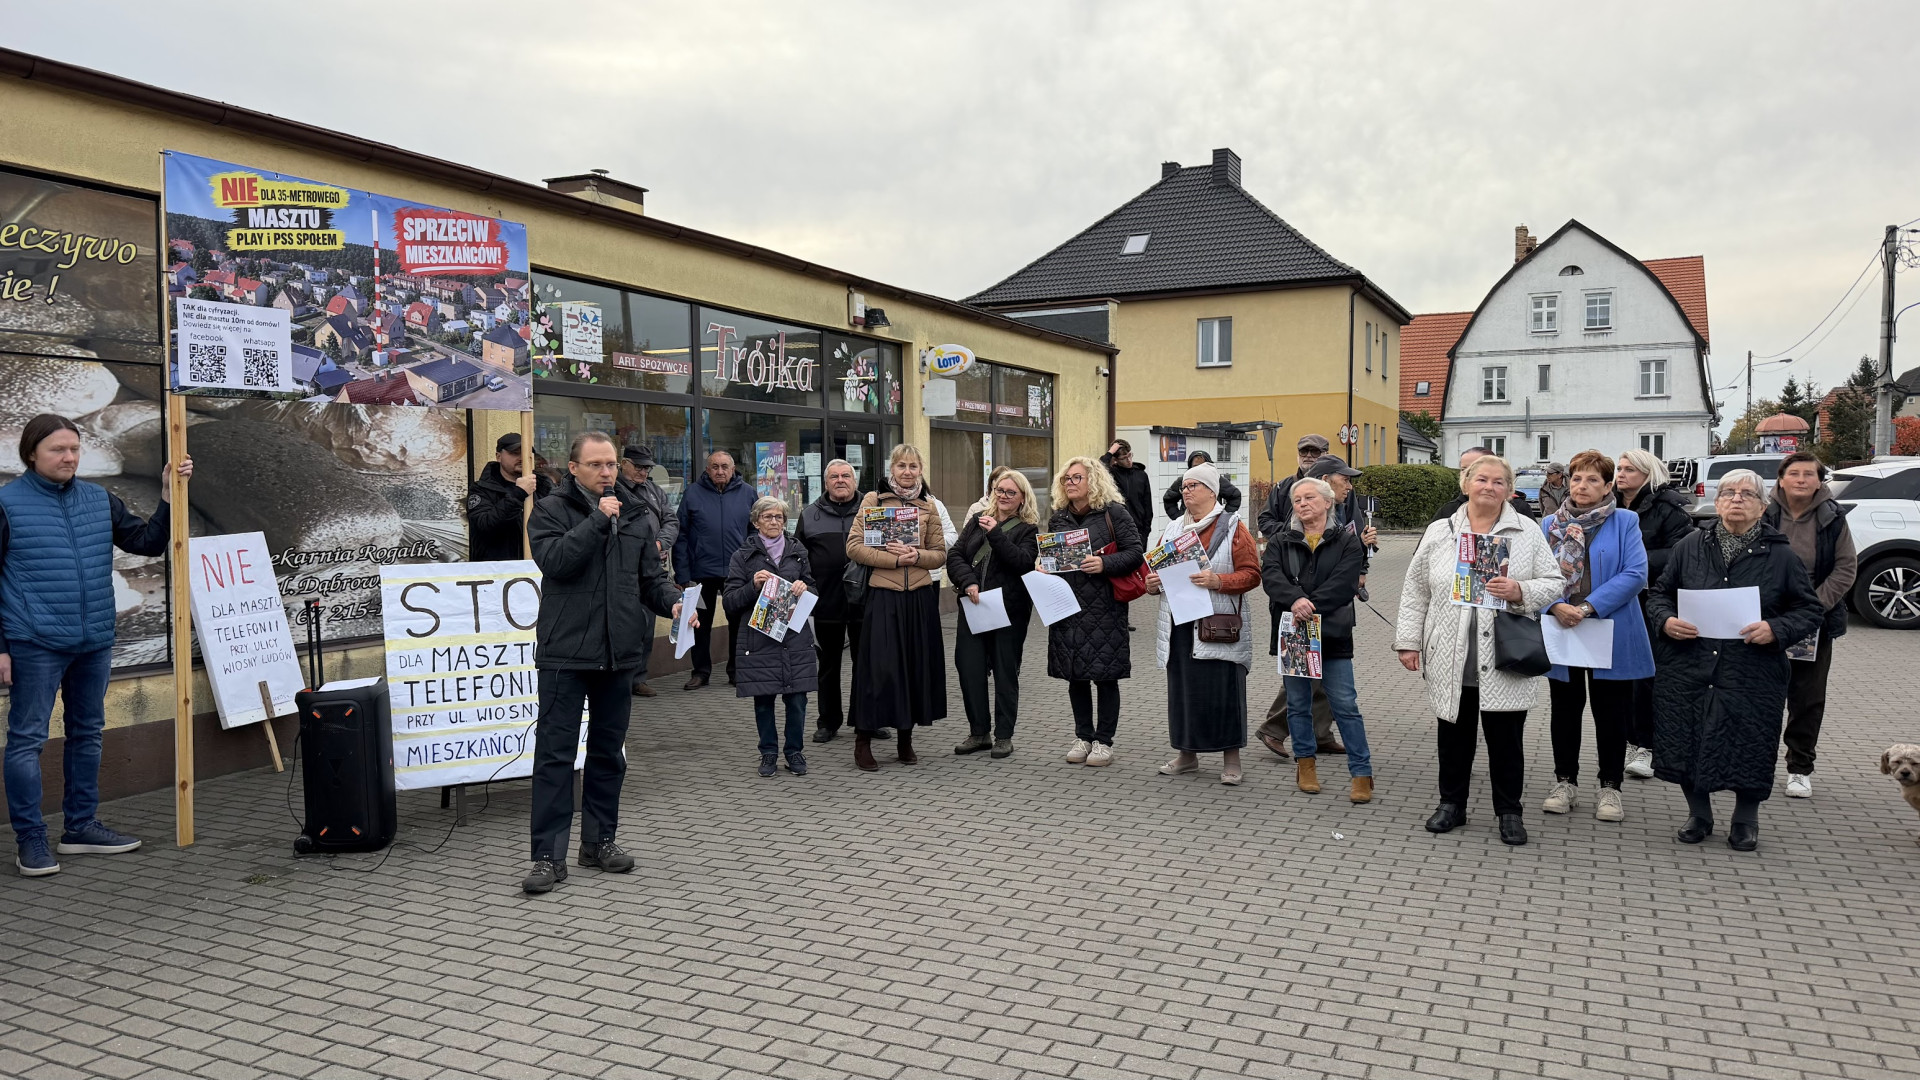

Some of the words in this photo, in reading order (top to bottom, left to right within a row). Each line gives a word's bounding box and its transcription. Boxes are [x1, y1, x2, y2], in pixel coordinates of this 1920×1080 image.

[221, 177, 259, 202] NIE
[261, 188, 277, 201] DLA
[278, 189, 340, 204] 35-METROWEGO
[248, 208, 320, 229] MASZTU
[236, 232, 264, 246] PLAY
[267, 232, 271, 245] i
[274, 233, 294, 246] PSS
[296, 233, 337, 246] SPOŁEM
[403, 217, 489, 243] SPRZECIW
[0, 223, 138, 269] eczywo
[405, 243, 502, 265] MIESZKAŃCÓW!
[0, 270, 34, 302] ie
[182, 303, 196, 312] TAK
[197, 305, 207, 313] dla
[208, 307, 240, 316] cyfryzacji.
[182, 312, 194, 320] NIE
[196, 313, 206, 321] dla
[208, 315, 230, 323] masztu
[231, 316, 246, 325] 10m
[183, 320, 212, 329] Dowiedz
[190, 332, 224, 342] facebook
[243, 338, 276, 347] whatsapp
[618, 355, 637, 368] ART.
[706, 322, 815, 394] Trójka
[937, 354, 961, 369] LOTTO
[270, 546, 353, 569] ekarnia
[358, 540, 438, 565] Rogalik
[201, 550, 255, 592] NIE
[297, 572, 381, 598] Dąbrow
[211, 605, 236, 619] DLA
[240, 596, 282, 614] MASZTU
[400, 577, 542, 638] STO
[214, 620, 279, 643] TELEFONII
[230, 642, 249, 657] PRZY
[254, 638, 278, 651] ULICY
[222, 655, 258, 675] WIOSNY
[399, 655, 424, 670] DLA
[403, 670, 538, 707] TELEFONI
[407, 713, 436, 730] PRZY
[448, 710, 468, 725] UL.
[407, 731, 525, 767] MIESZKAŃCY
